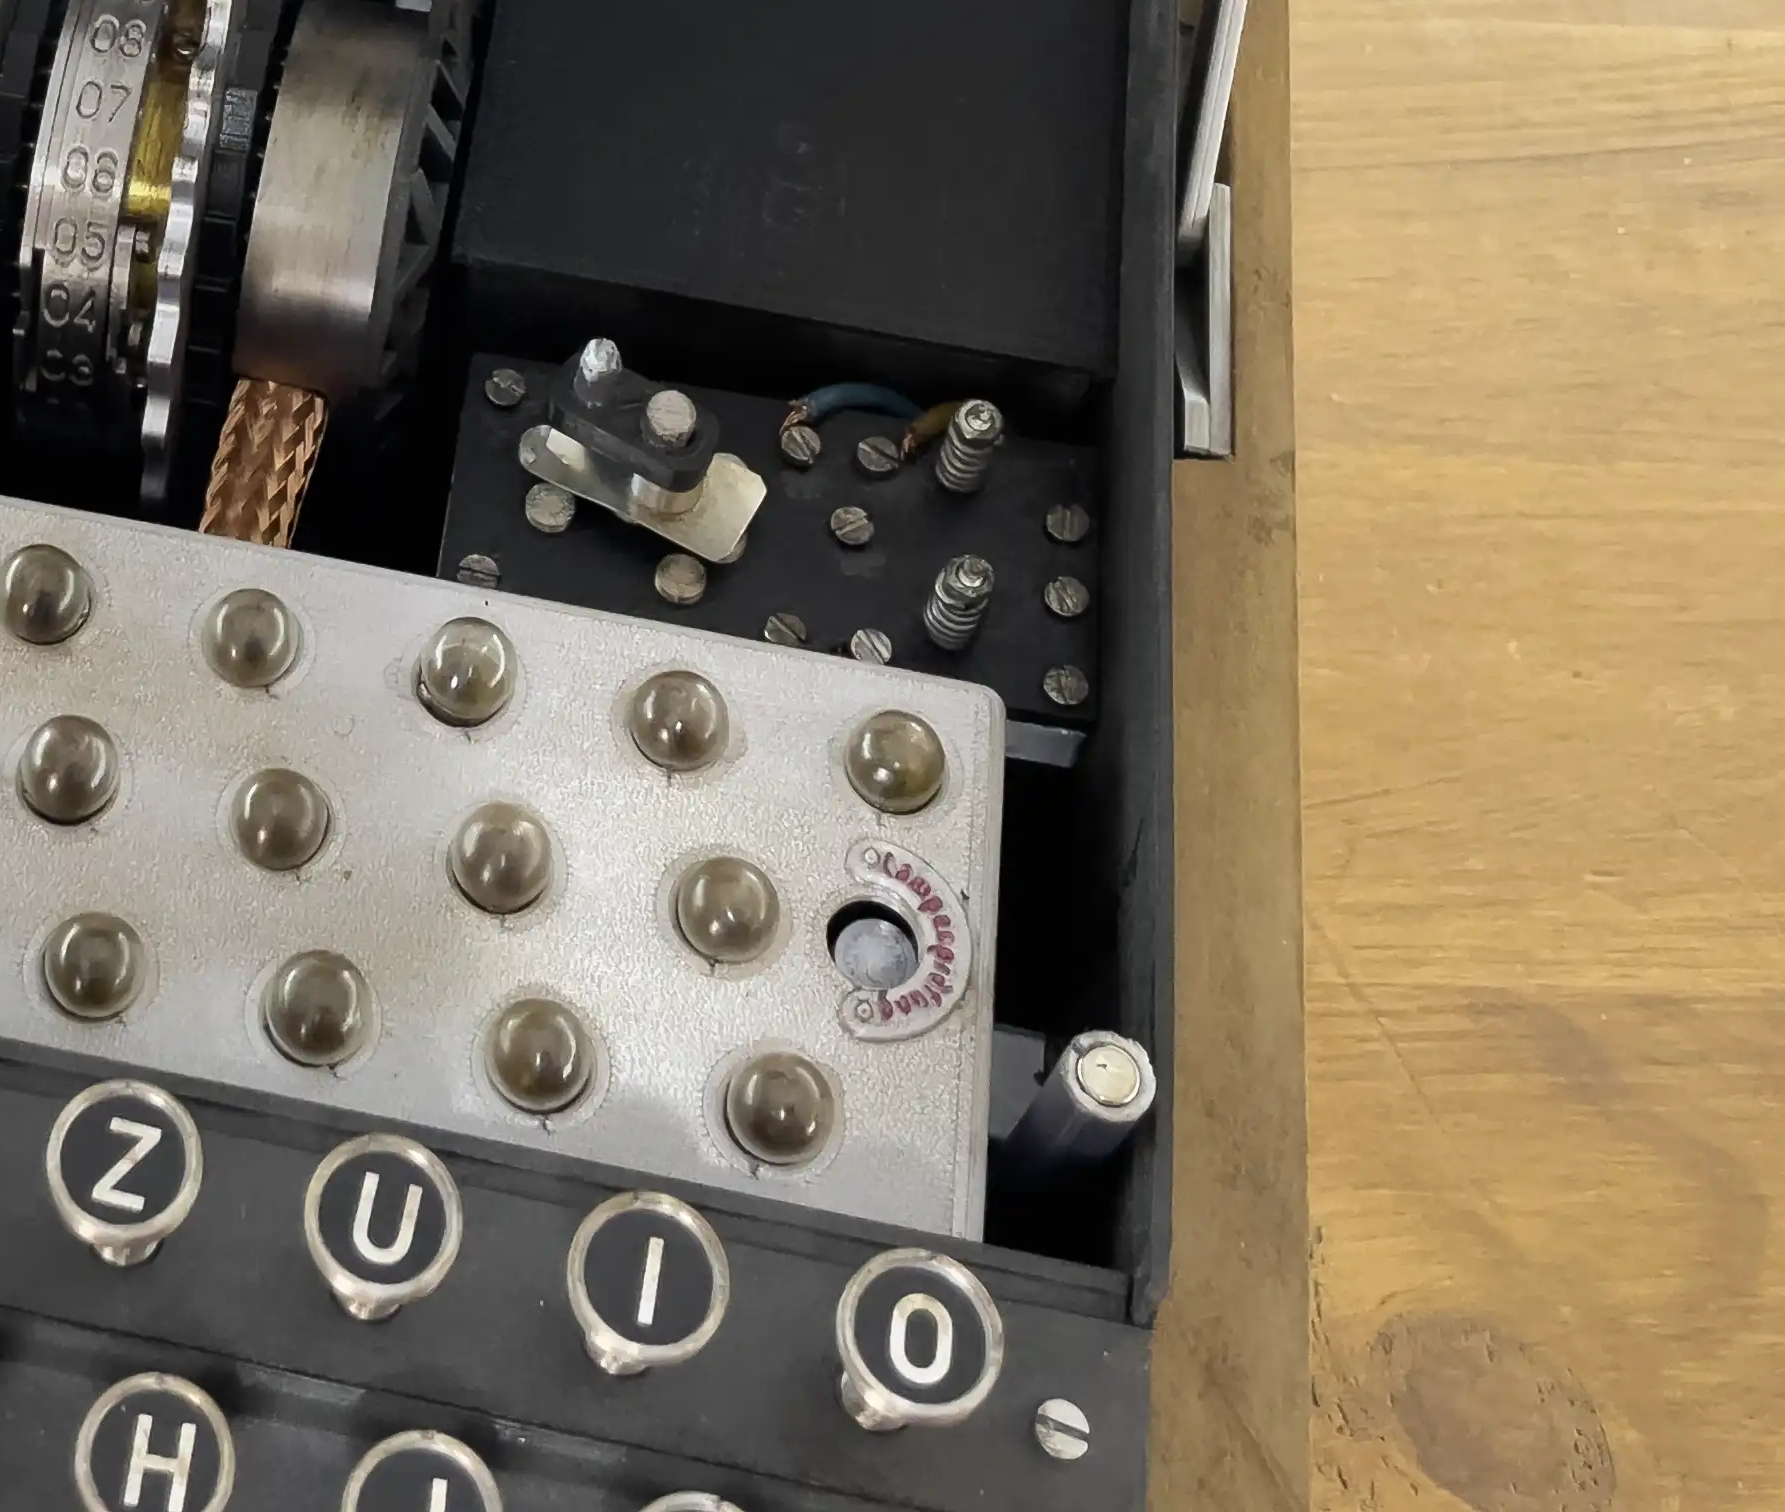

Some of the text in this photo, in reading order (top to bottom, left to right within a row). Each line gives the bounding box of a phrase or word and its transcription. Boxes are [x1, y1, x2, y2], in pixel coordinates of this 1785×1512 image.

[90, 15, 147, 58] 08
[75, 80, 132, 123] 07
[53, 217, 106, 264] 05
[43, 284, 97, 334] 04
[90, 1116, 163, 1213] Z
[351, 1171, 423, 1267] U
[637, 1236, 664, 1326] I
[123, 1412, 197, 1512] H
